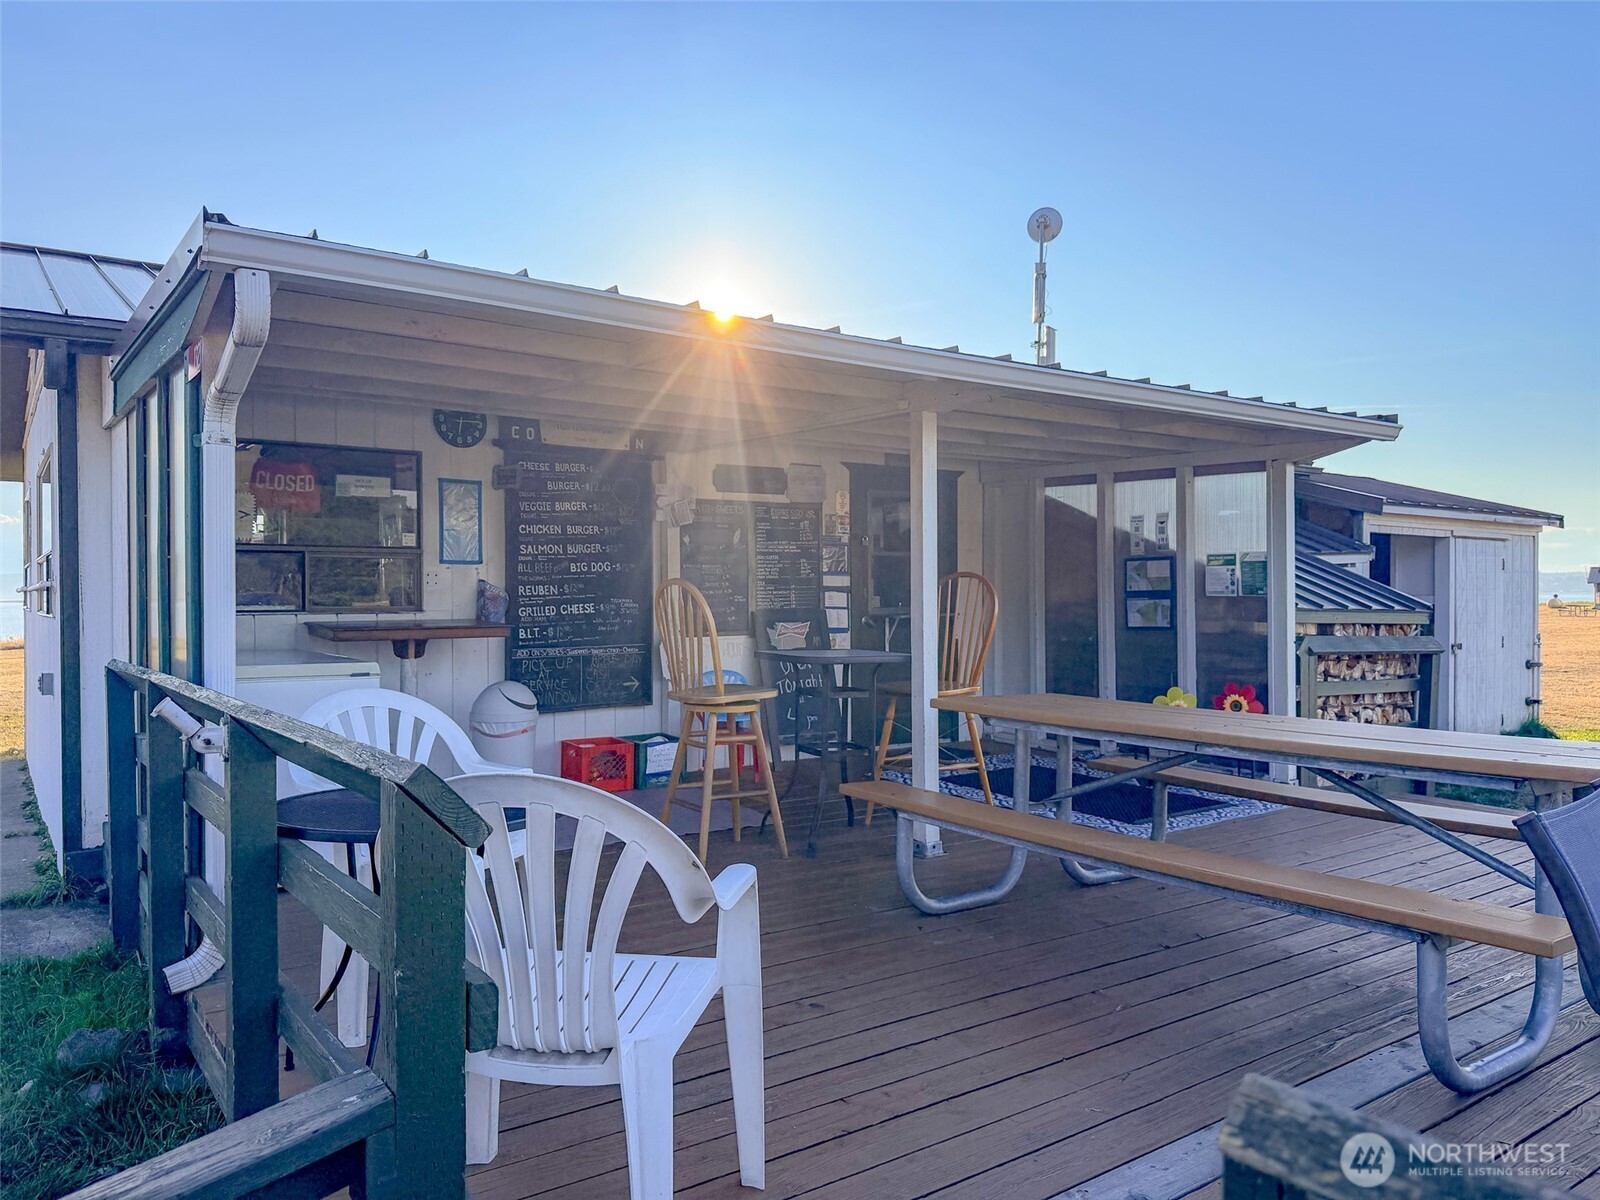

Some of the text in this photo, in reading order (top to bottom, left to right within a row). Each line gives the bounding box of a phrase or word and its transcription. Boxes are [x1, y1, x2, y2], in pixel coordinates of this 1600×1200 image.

[255, 470, 315, 493] CLOSED
[519, 501, 551, 511] VEGGIE
[771, 508, 804, 518] ESPRESSO
[518, 524, 562, 535] CHICKEN
[519, 544, 563, 554] SALMON
[518, 562, 532, 573] ALL
[534, 562, 553, 573] BEEF
[570, 562, 588, 572] BIG
[518, 606, 557, 617] GRILLED
[518, 628, 541, 639] B.L.T.
[522, 658, 574, 673] PICK UP
[538, 669, 553, 680] AT
